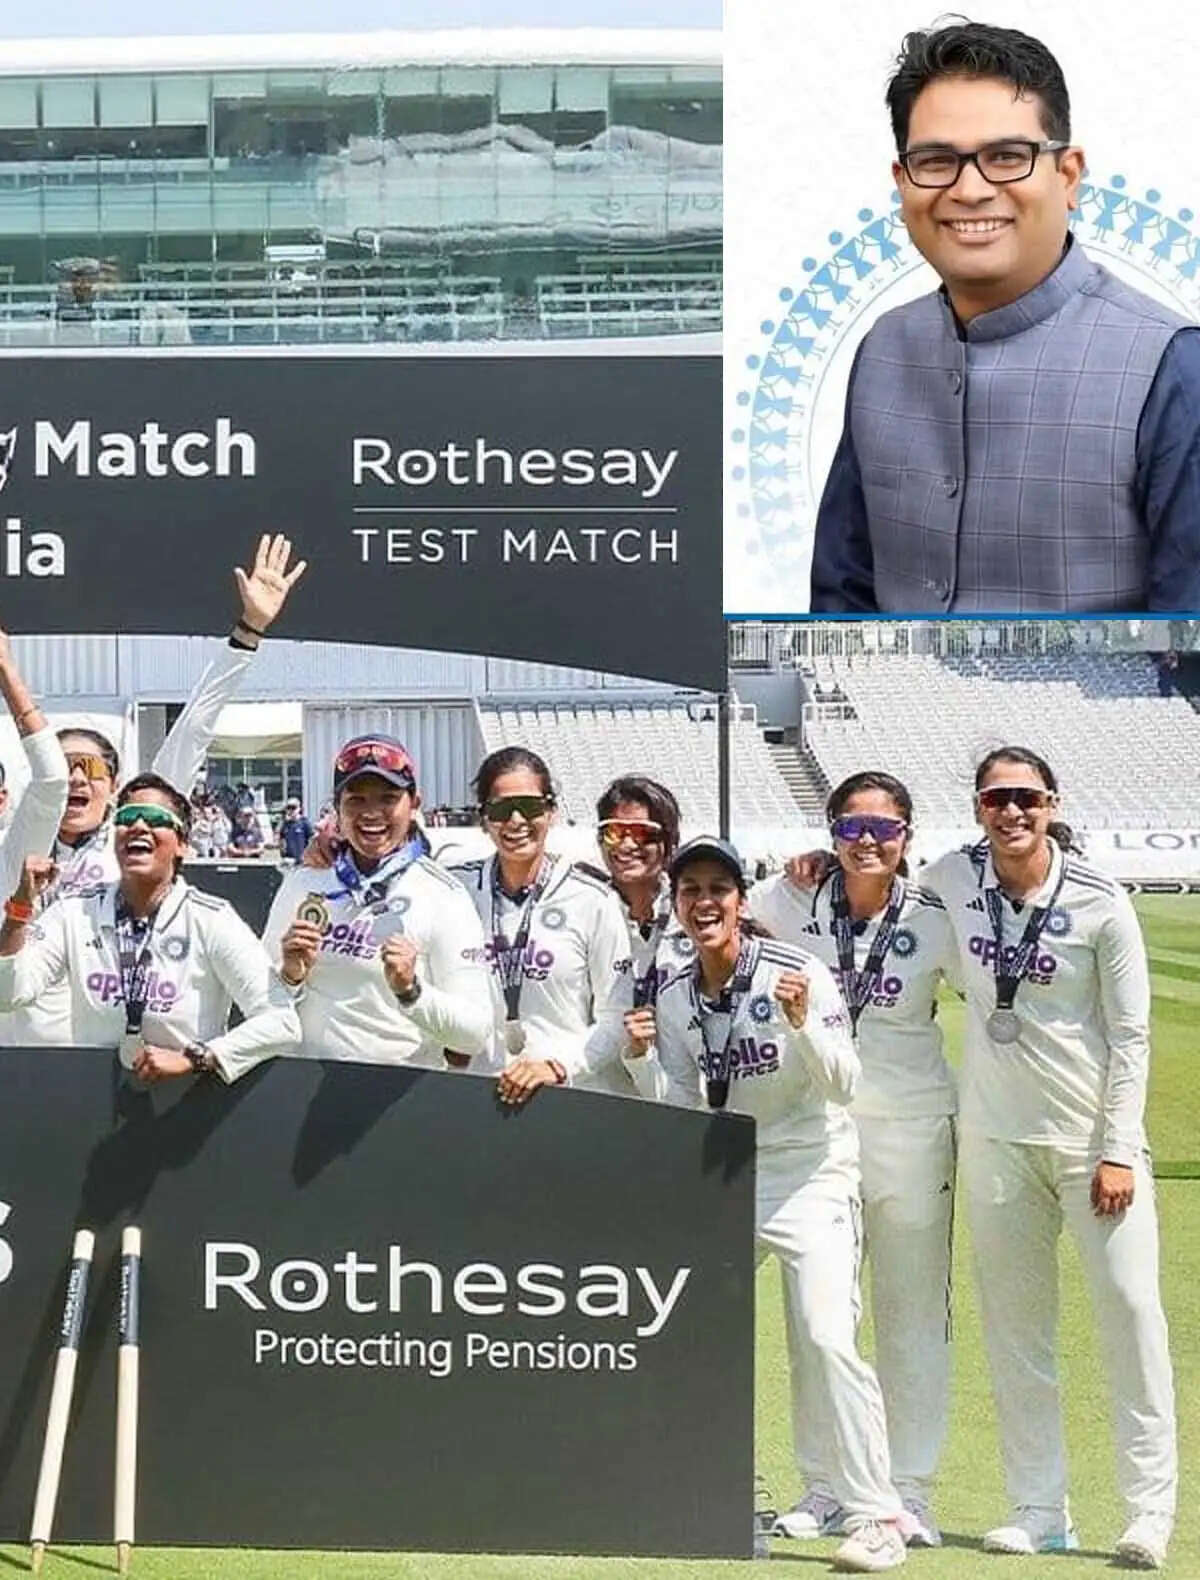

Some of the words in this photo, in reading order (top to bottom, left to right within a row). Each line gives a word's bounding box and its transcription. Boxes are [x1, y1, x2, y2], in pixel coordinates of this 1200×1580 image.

[35, 417, 256, 477] Match
[352, 438, 679, 498] Rothesay
[352, 528, 478, 563] TEST
[503, 528, 679, 563] MATCH
[204, 1242, 692, 1336] Rothesay
[254, 1329, 453, 1377] Protecting
[465, 1333, 638, 1370] Pensions
